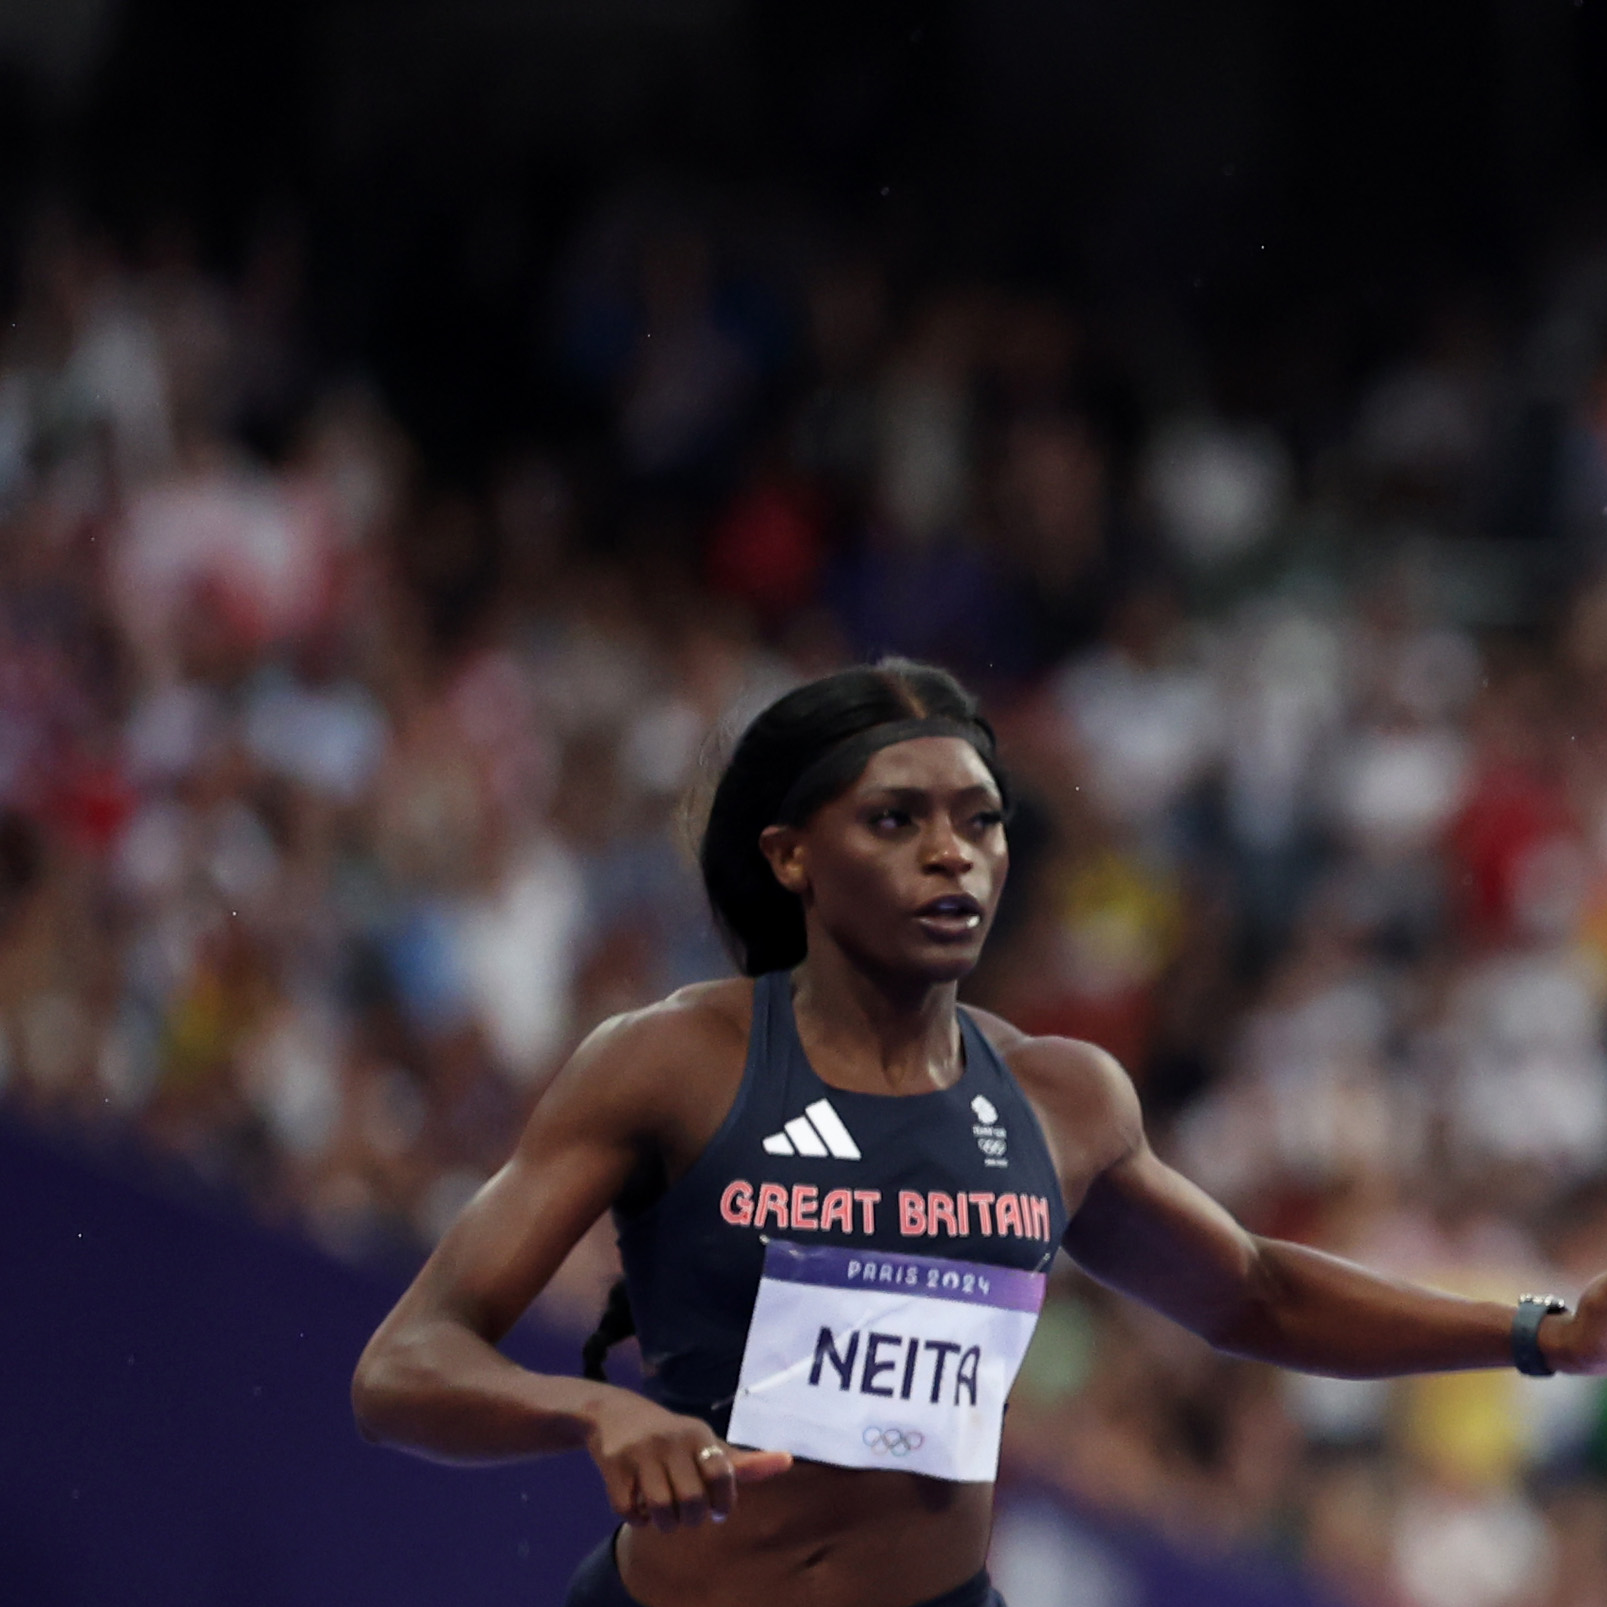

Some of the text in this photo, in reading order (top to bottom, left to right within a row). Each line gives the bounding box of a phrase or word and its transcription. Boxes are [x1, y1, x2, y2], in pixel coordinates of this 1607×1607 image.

[720, 1180, 1050, 1242] GREAT BRITAIN
[847, 1260, 990, 1295] PARIS 2024
[808, 1325, 981, 1406] NEITA
